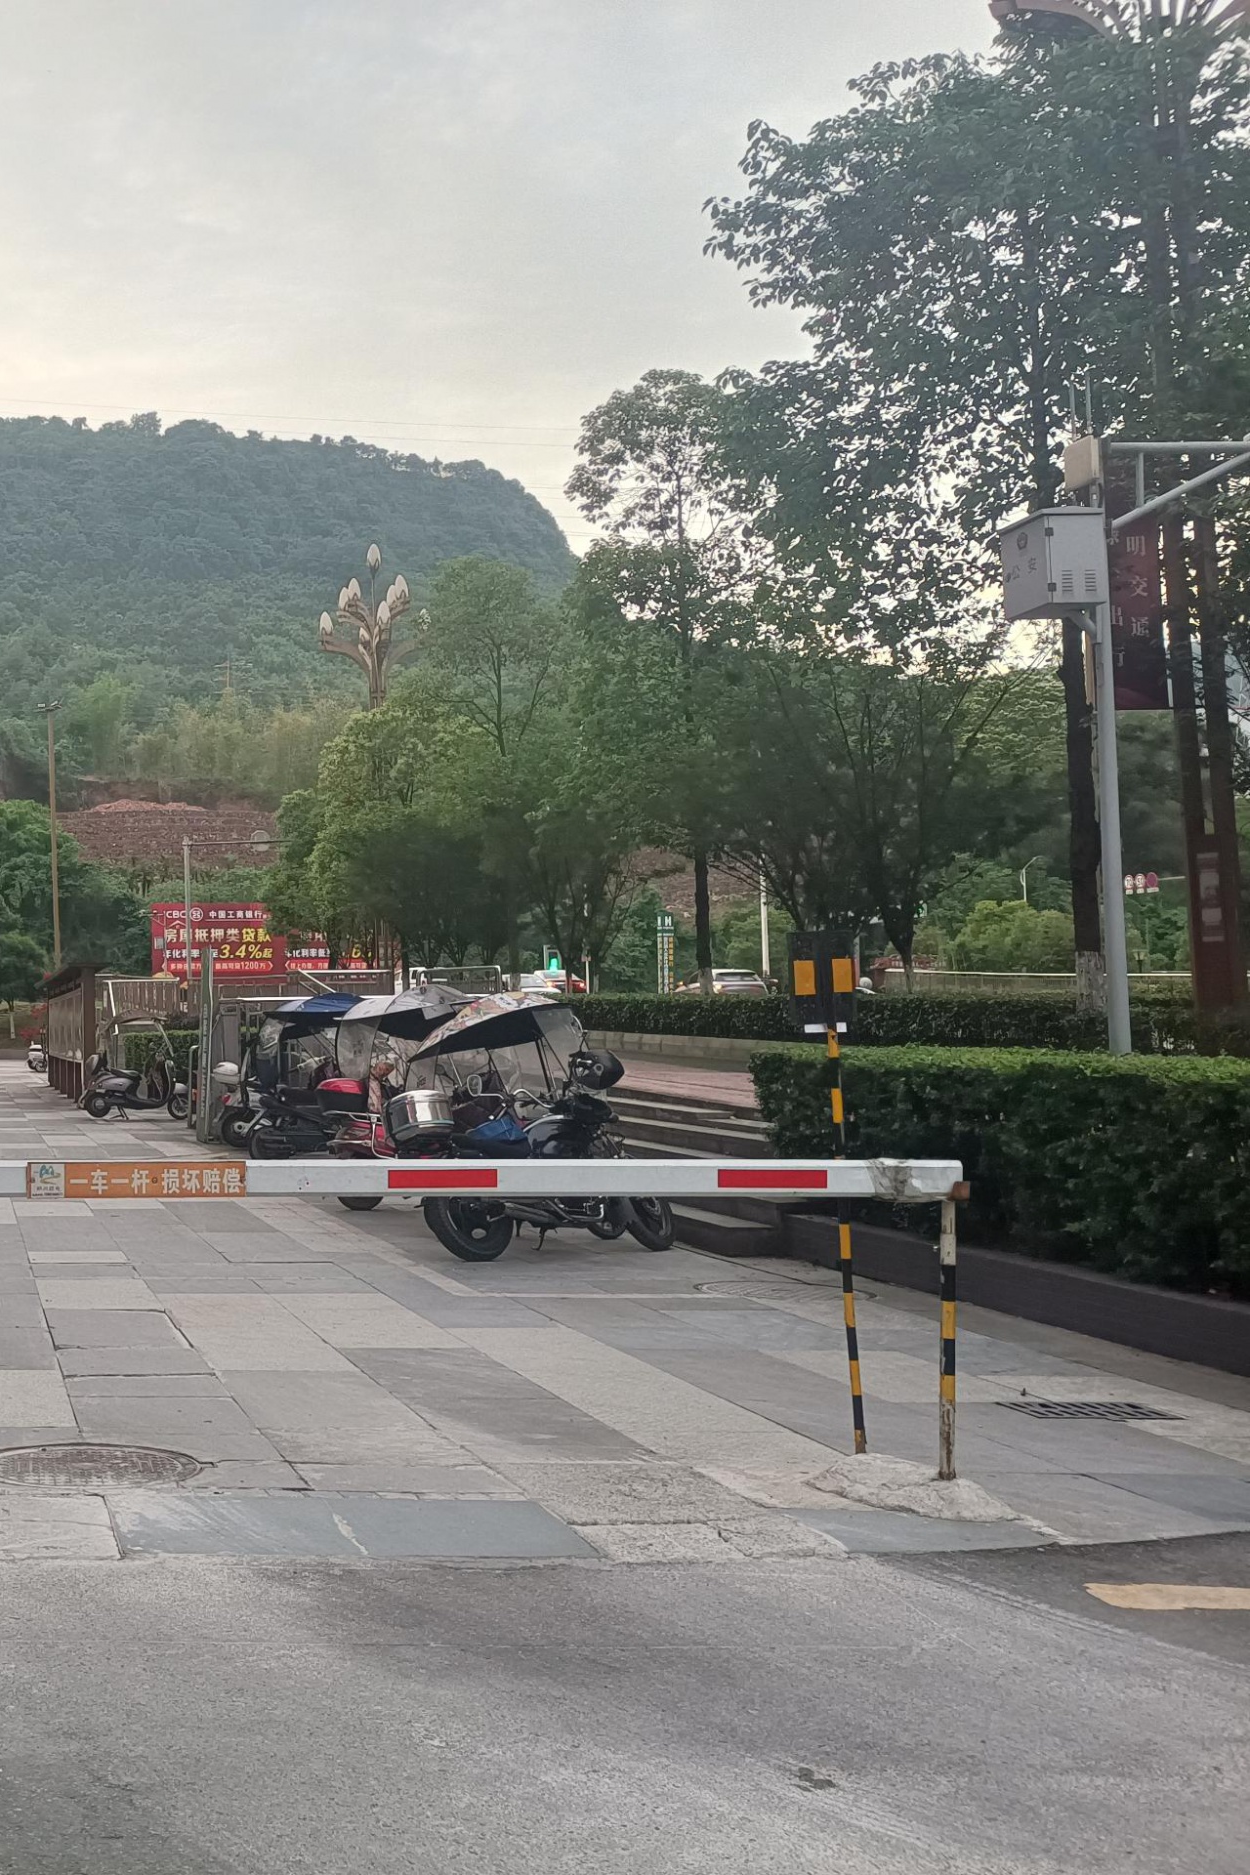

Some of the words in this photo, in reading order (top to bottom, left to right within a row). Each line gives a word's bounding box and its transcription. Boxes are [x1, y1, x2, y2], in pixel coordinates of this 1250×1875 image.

[209, 910, 263, 919] 中国工商银行
[70, 1169, 150, 1195] 一车一杆
[162, 1167, 241, 1195] 损坏赔偿
